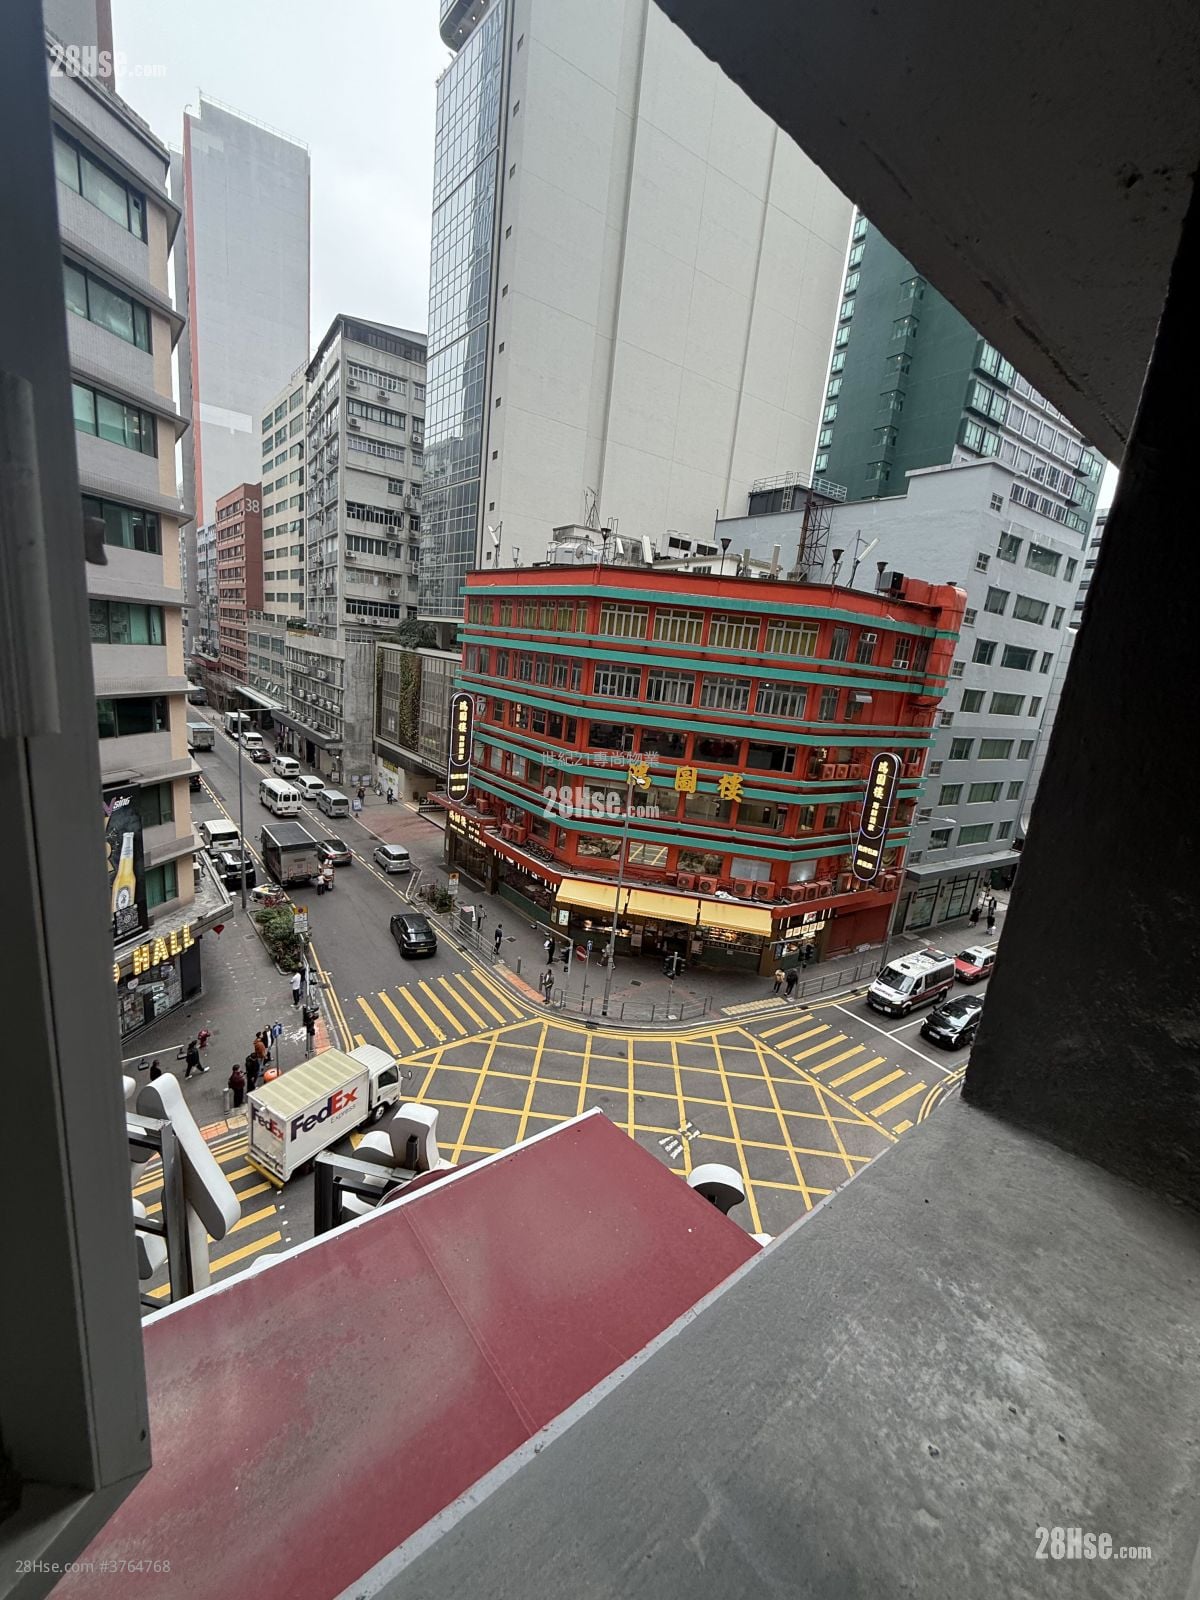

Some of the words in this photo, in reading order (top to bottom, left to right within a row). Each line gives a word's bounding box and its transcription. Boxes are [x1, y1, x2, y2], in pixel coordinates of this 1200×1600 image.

[245, 498, 260, 513] 38
[133, 922, 195, 976] HALL
[252, 1104, 284, 1141] FedEx
[290, 1087, 359, 1142] FedEx
